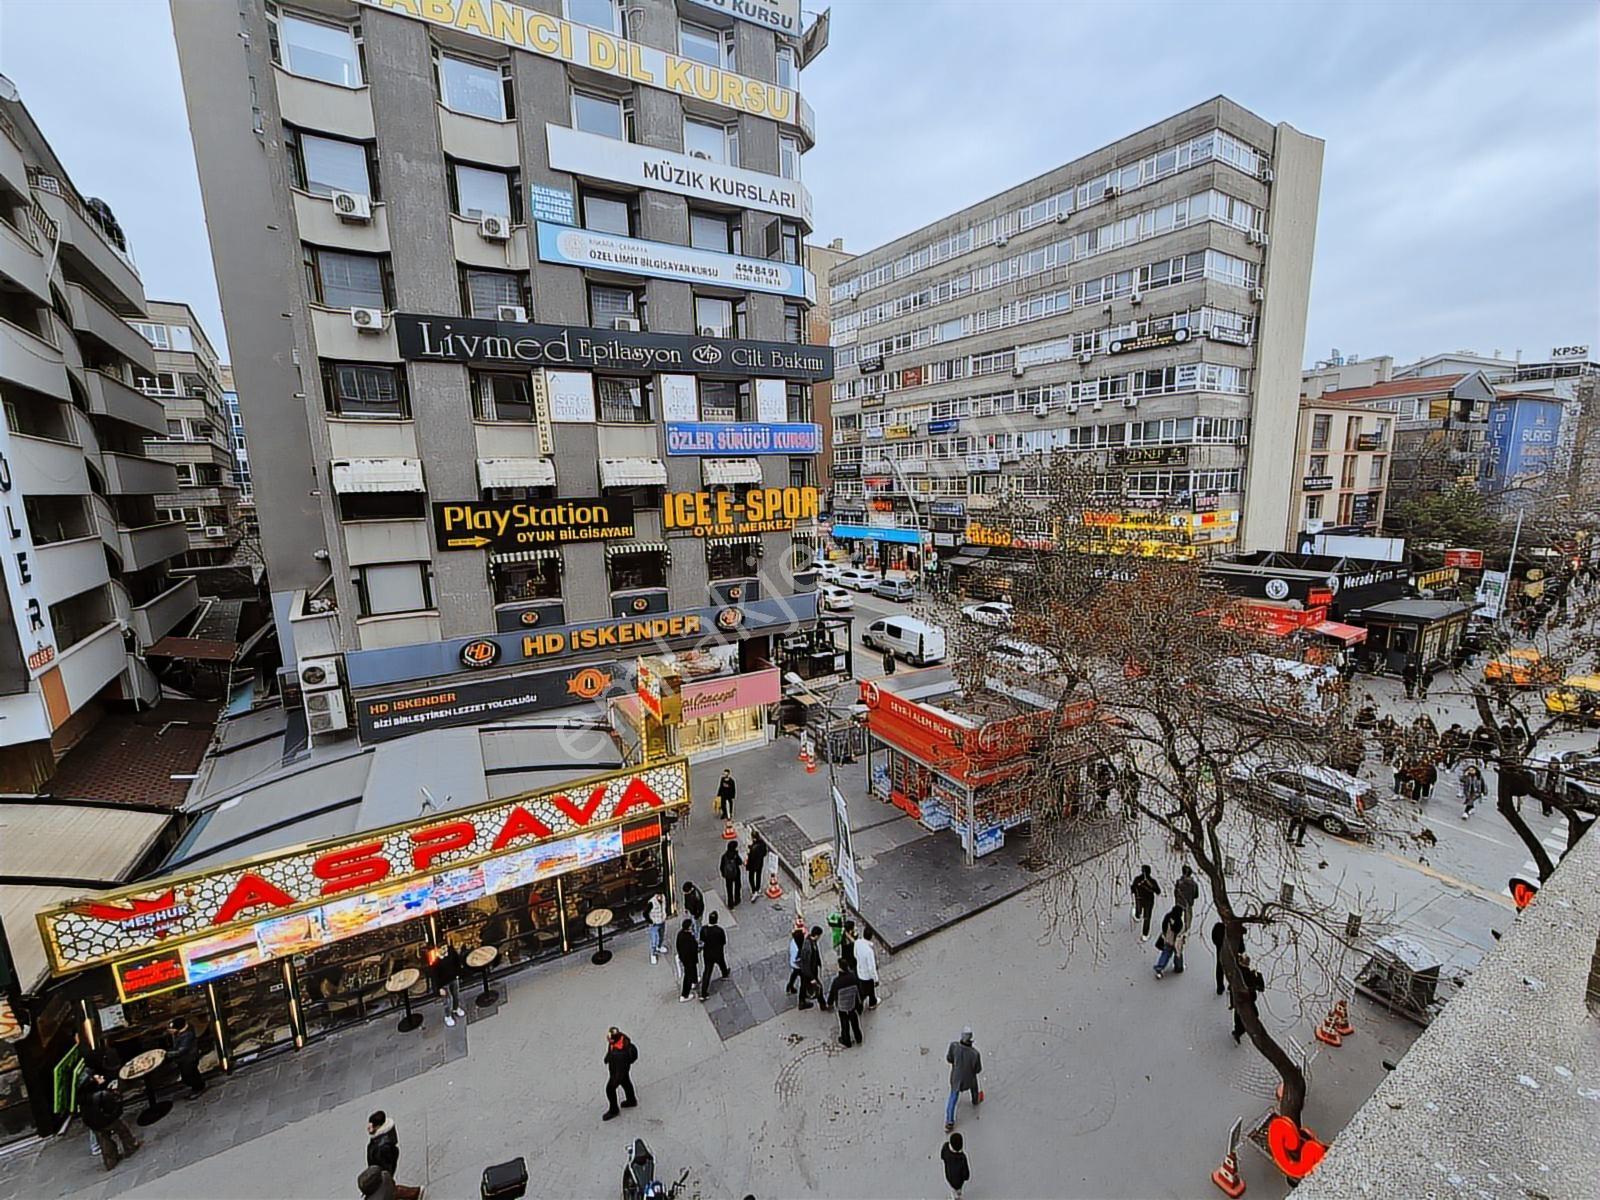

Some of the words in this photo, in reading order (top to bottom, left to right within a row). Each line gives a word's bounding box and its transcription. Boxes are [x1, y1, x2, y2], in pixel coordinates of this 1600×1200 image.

[665, 55, 791, 120] KURSU
[709, 175, 796, 209] KURSLARI
[417, 321, 573, 362] Livmed
[577, 338, 682, 368] Epilasyon
[731, 349, 765, 367] Cilt
[772, 351, 824, 371] Bakımı
[1552, 345, 1588, 357] KPSS
[668, 426, 714, 451] ÖZLER
[717, 427, 771, 451] SÜRÜCÜ
[664, 491, 712, 528] ICE
[717, 486, 819, 524] E-SPOR
[517, 530, 555, 543] OYUN
[559, 524, 634, 541] BİLGİSAYARI
[693, 523, 735, 537] OYUN
[522, 633, 565, 657] HD
[369, 703, 389, 716] HD
[453, 704, 486, 716] LEZZET
[121, 903, 189, 932] MEŞHUR
